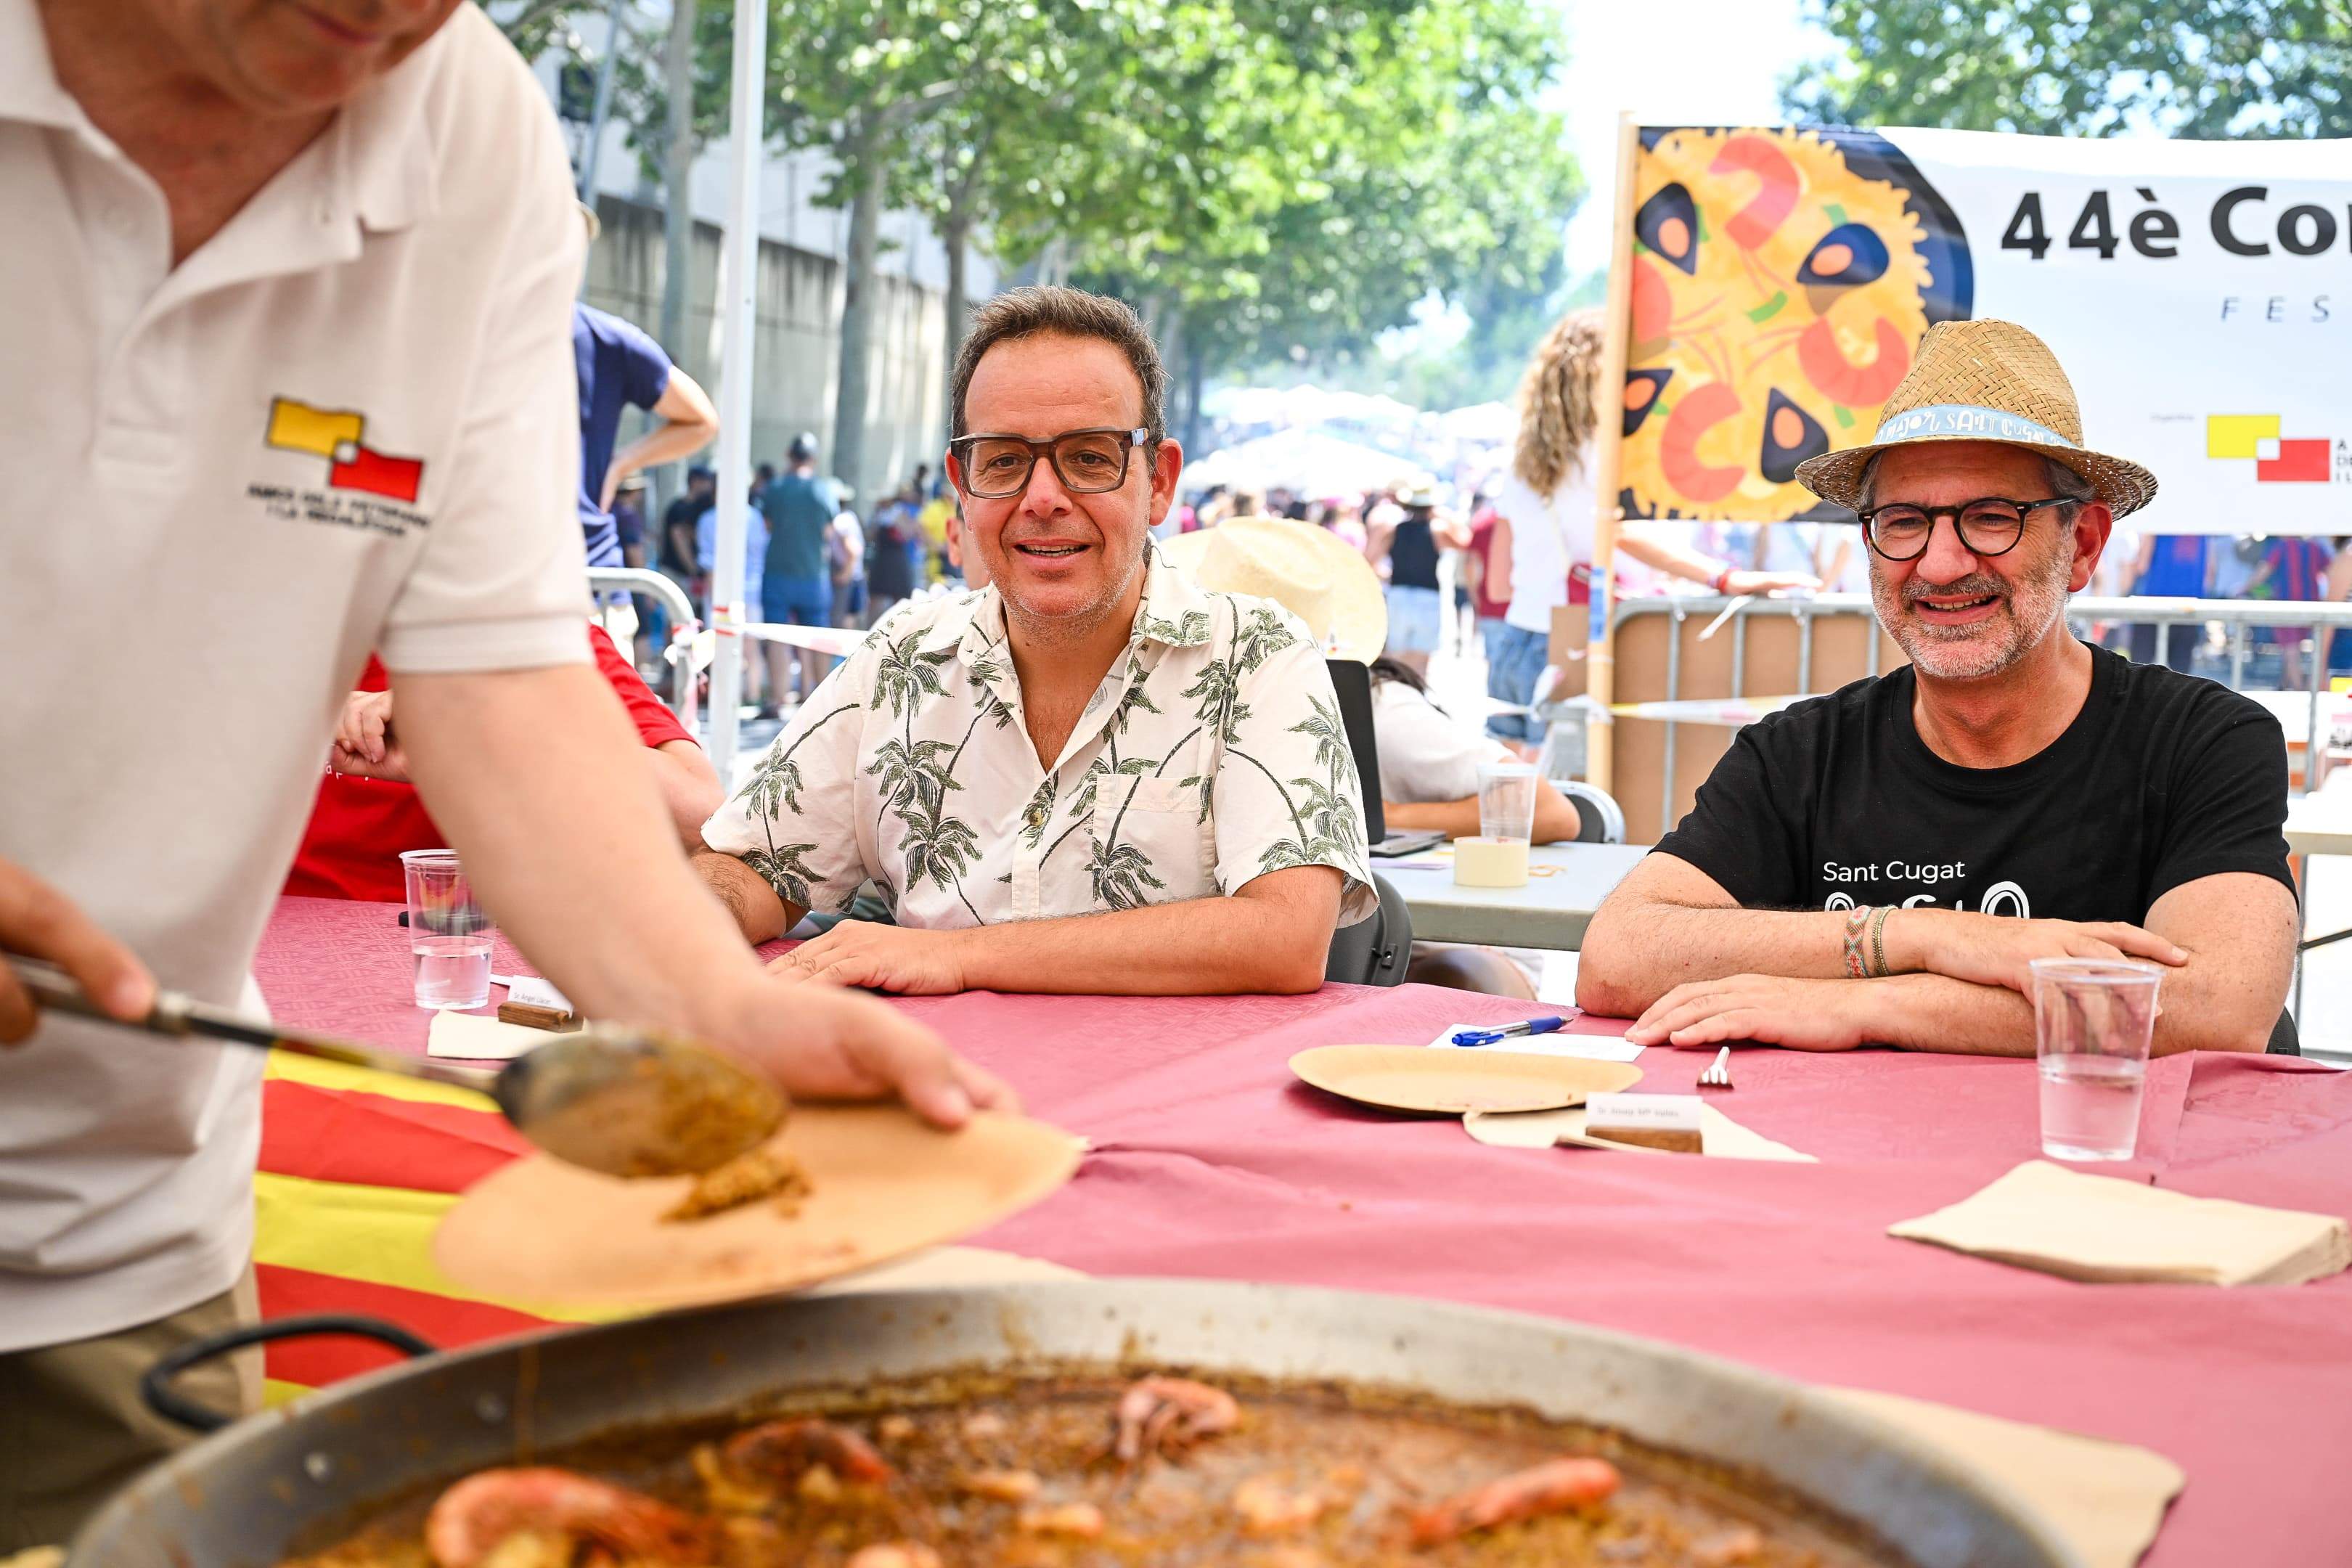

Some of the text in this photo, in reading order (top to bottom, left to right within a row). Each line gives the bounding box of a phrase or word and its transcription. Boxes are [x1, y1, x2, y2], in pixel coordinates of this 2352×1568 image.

[2001, 186, 2352, 259] 44è Co
[1823, 860, 1966, 884] Sant Cugat
